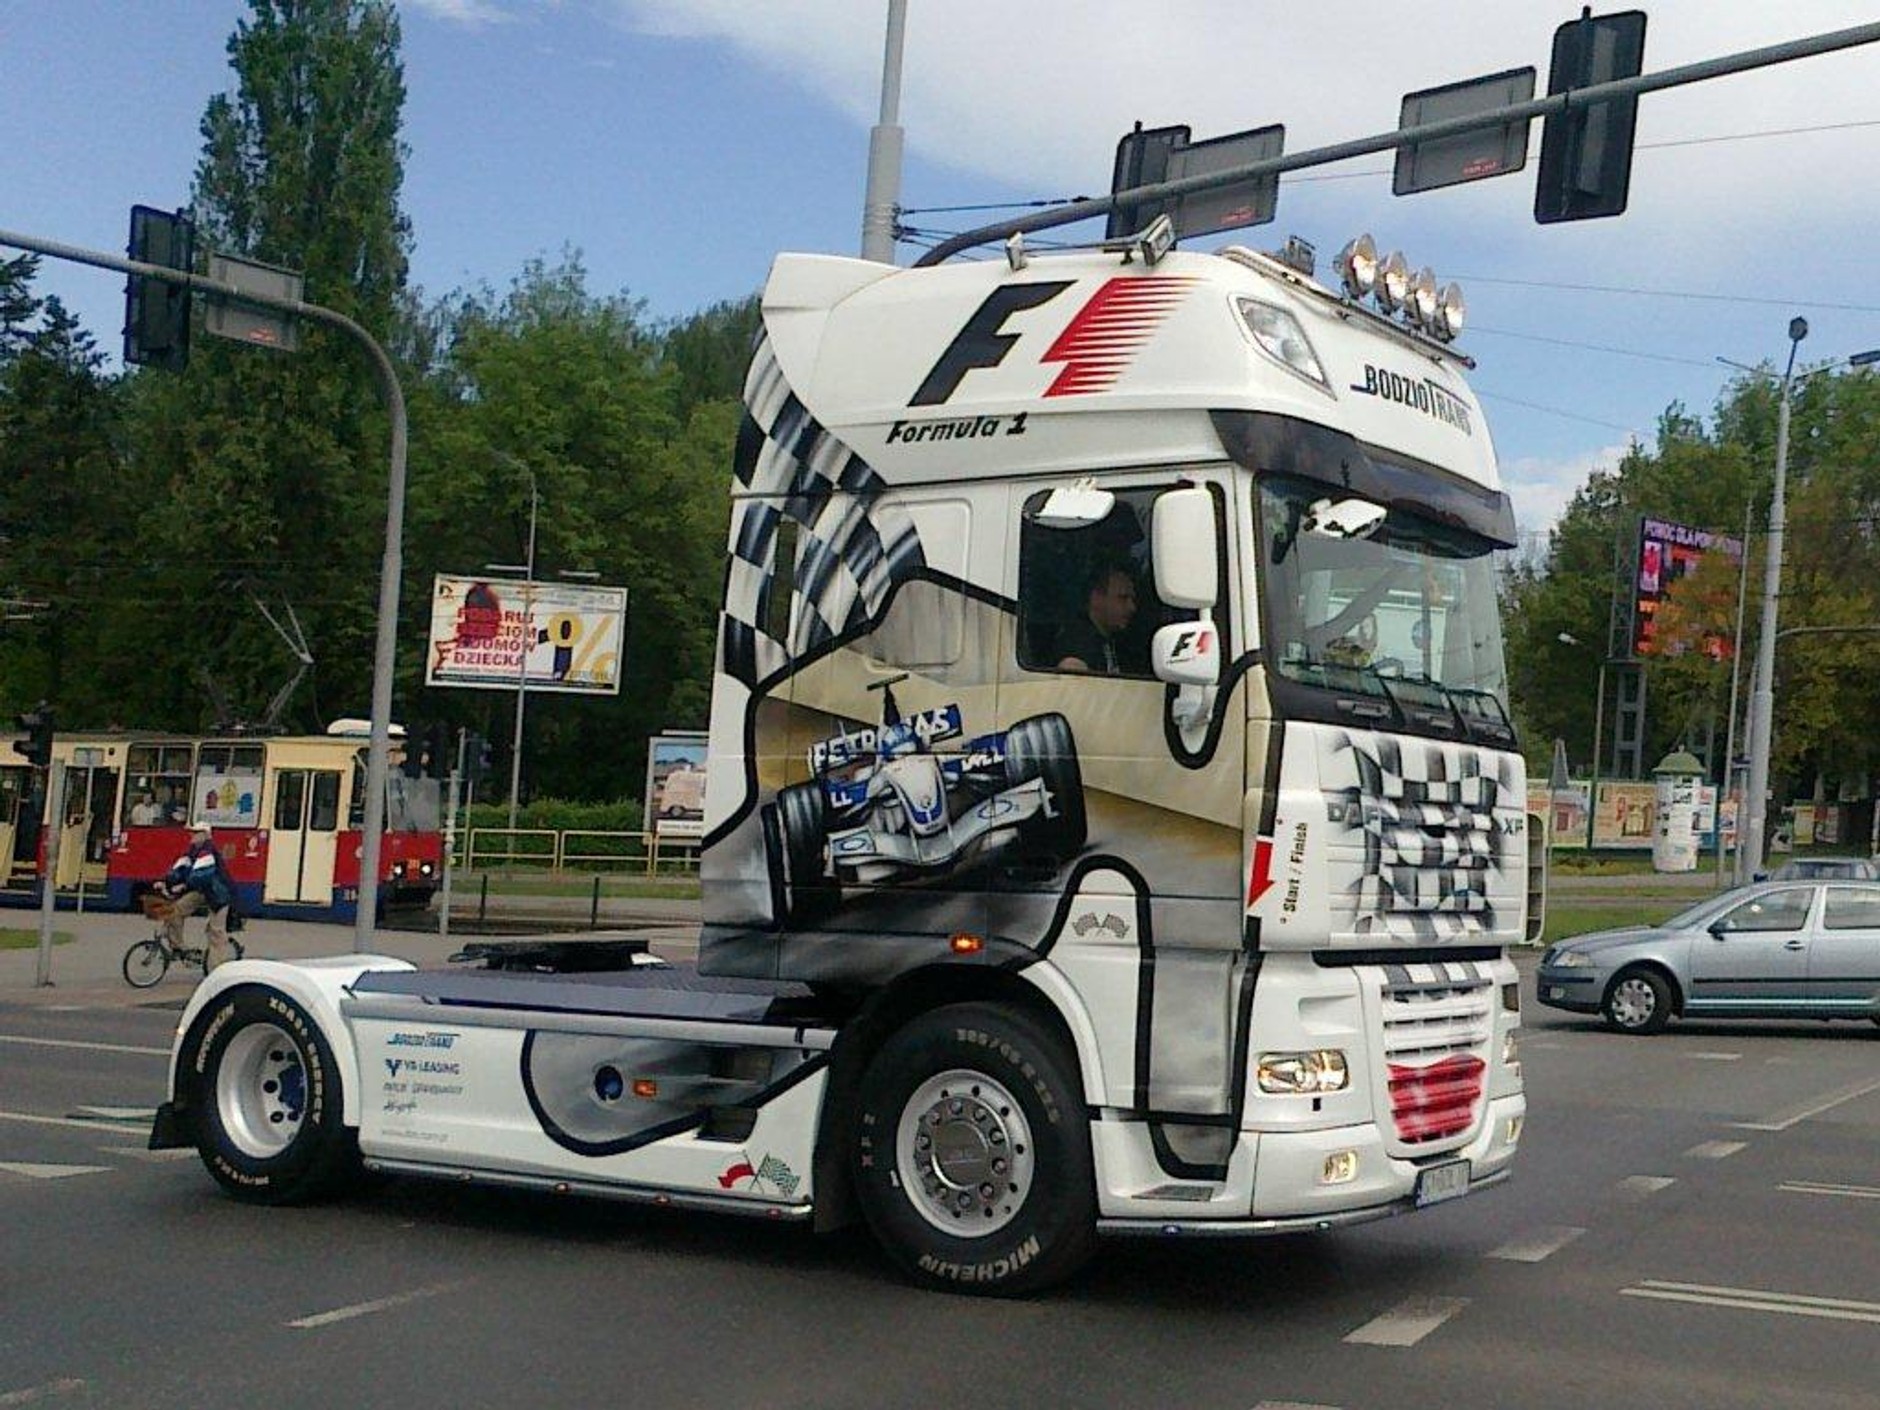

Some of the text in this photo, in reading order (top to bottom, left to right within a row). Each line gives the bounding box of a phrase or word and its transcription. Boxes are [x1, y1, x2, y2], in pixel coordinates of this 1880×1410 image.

[885, 412, 1029, 444] Formula 1
[917, 1234, 1042, 1283] MICHELIN
